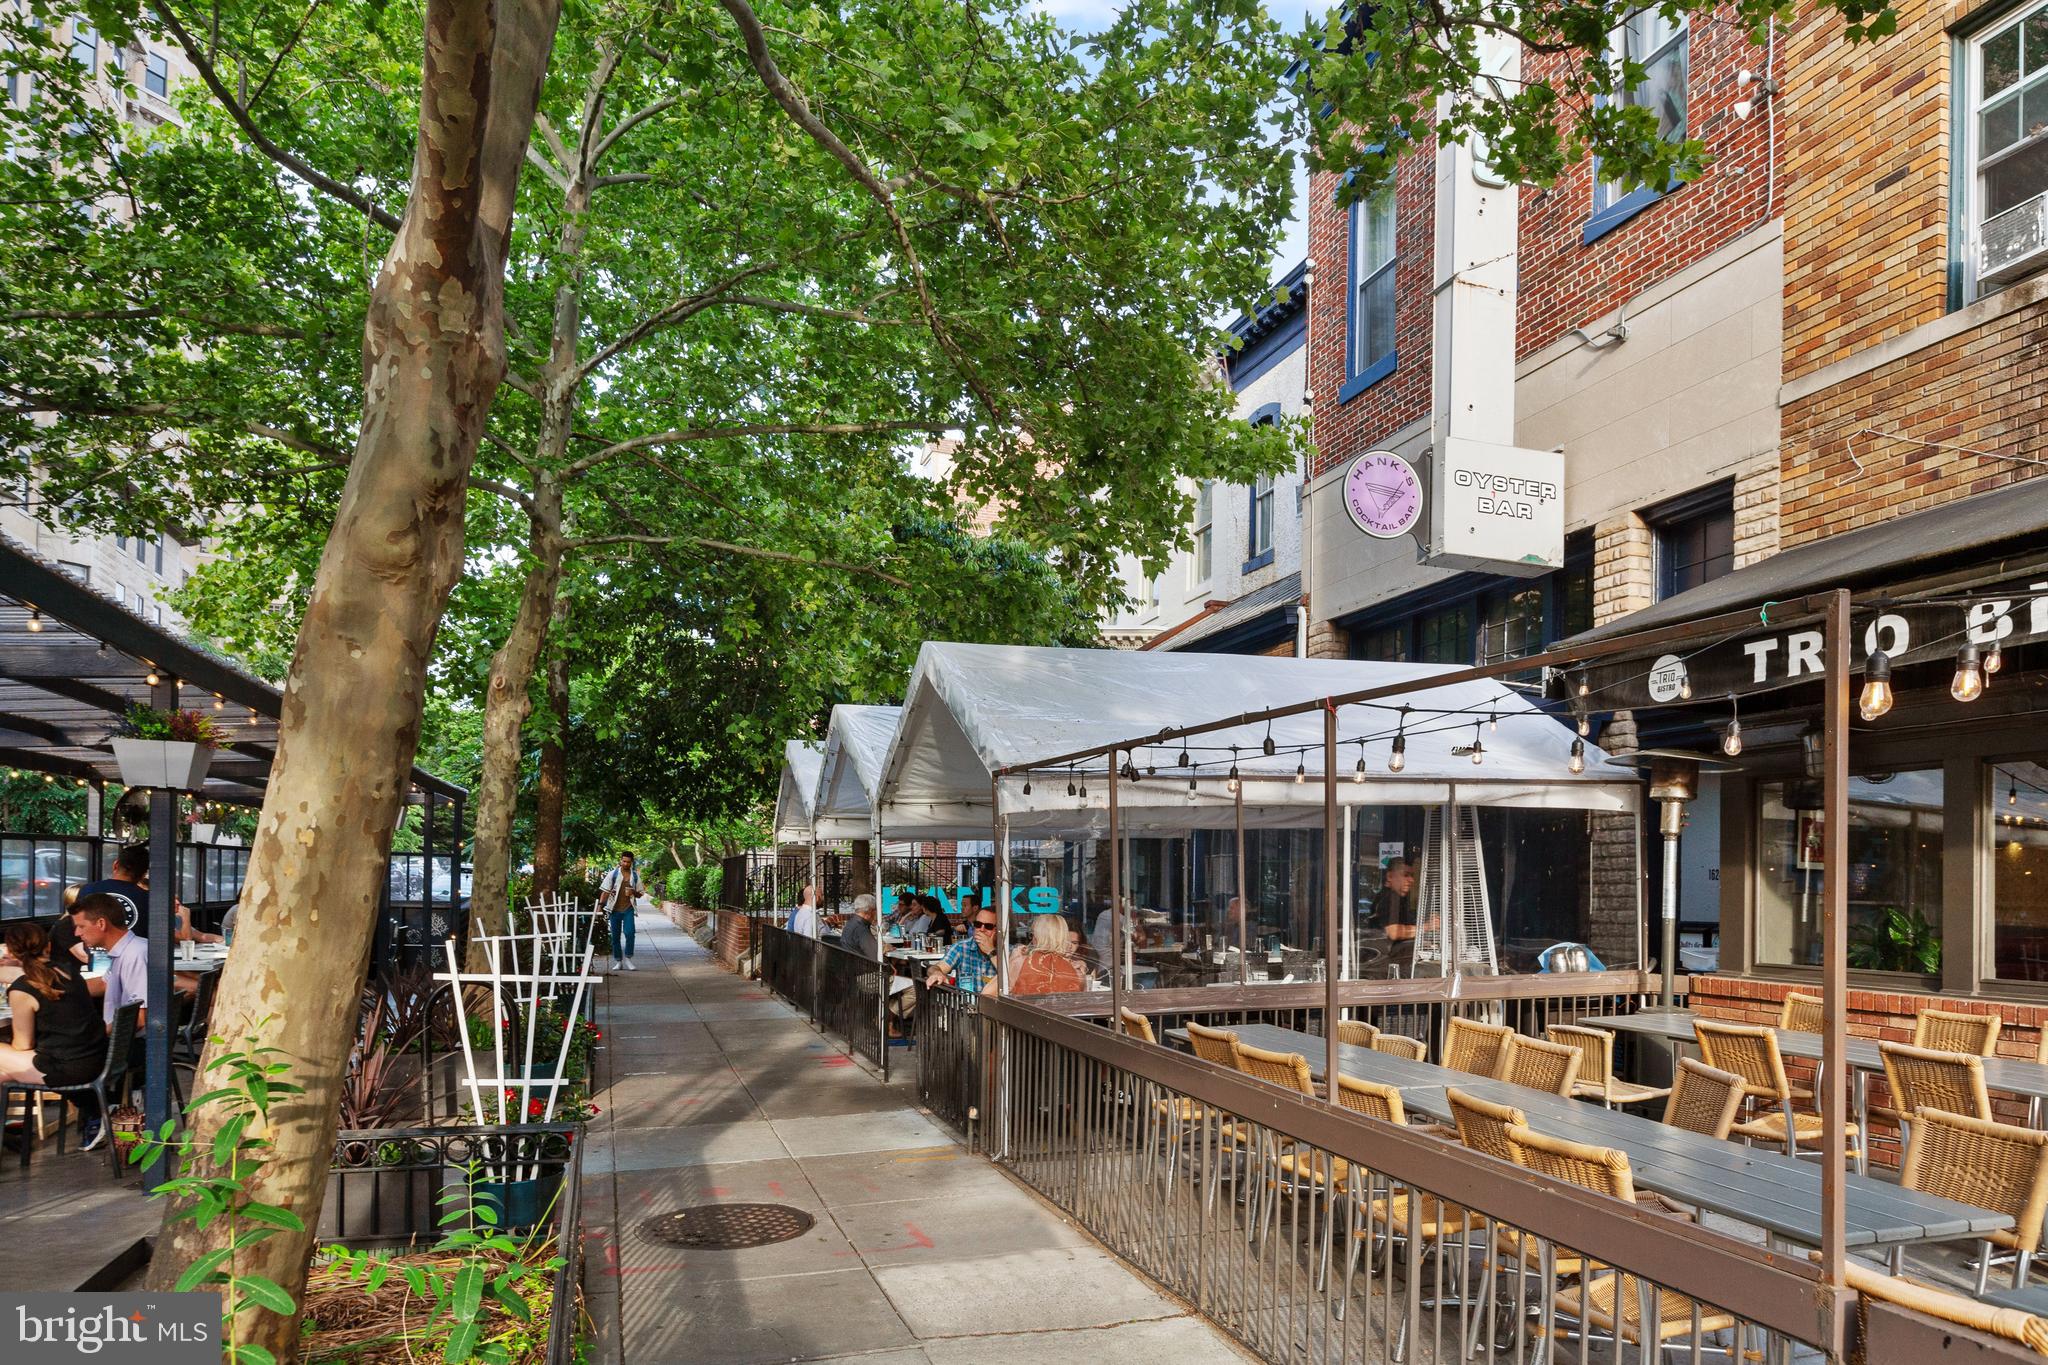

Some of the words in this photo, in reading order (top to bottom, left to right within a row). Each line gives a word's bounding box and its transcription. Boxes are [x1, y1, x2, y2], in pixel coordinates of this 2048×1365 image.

[1353, 457, 1415, 487] HANK'S
[1454, 469, 1557, 500] OYSTER
[1352, 498, 1398, 531] COCKTAIL
[1398, 505, 1415, 526] BAR
[1478, 496, 1533, 520] BAR
[1744, 613, 1911, 684] TRO
[1656, 669, 1676, 685] TRIO
